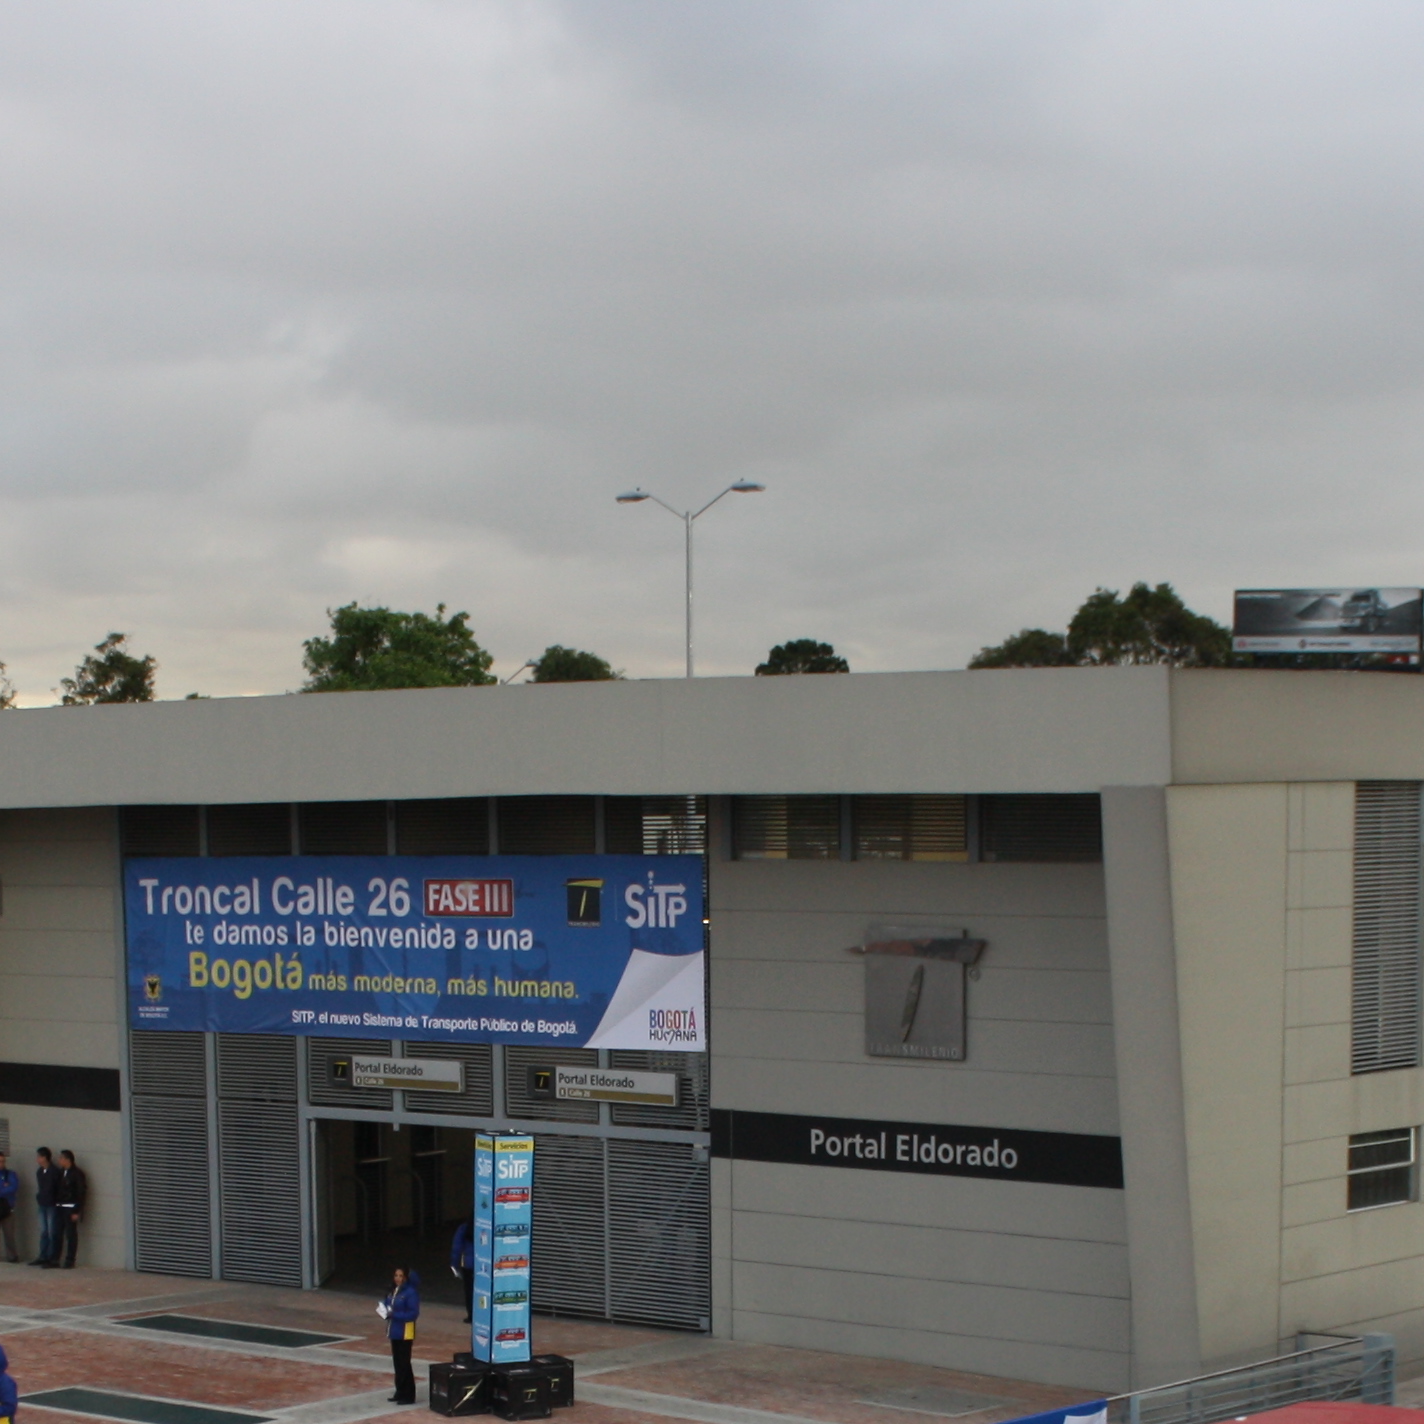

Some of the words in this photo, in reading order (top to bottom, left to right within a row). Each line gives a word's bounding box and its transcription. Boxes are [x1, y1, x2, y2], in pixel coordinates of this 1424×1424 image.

[139, 878, 260, 915] Troncal
[272, 876, 355, 916] Calle
[367, 877, 411, 917] 26
[428, 883, 479, 913] FASE
[186, 920, 204, 944] te
[213, 920, 288, 946] damos
[296, 920, 315, 946] la
[324, 921, 456, 950] bienvenida
[464, 927, 478, 949] a
[487, 928, 533, 951] una
[189, 951, 303, 999] Bogotá
[309, 971, 347, 991] más
[354, 974, 441, 998] moderna,
[447, 974, 487, 996] más
[494, 976, 579, 999] humana.
[330, 1014, 361, 1025] nuevo
[362, 1013, 402, 1028] Sistema
[405, 1015, 418, 1028] de
[421, 1016, 478, 1032] Transporte
[521, 1020, 535, 1032] de
[649, 1007, 696, 1030] BOGOTÁ
[355, 1062, 380, 1073] Portal
[383, 1064, 423, 1076] Eldorado
[558, 1073, 587, 1085] Portal
[590, 1075, 635, 1088] Eldorado
[810, 1128, 886, 1160] Portal
[896, 1134, 1018, 1169] Eldorado
